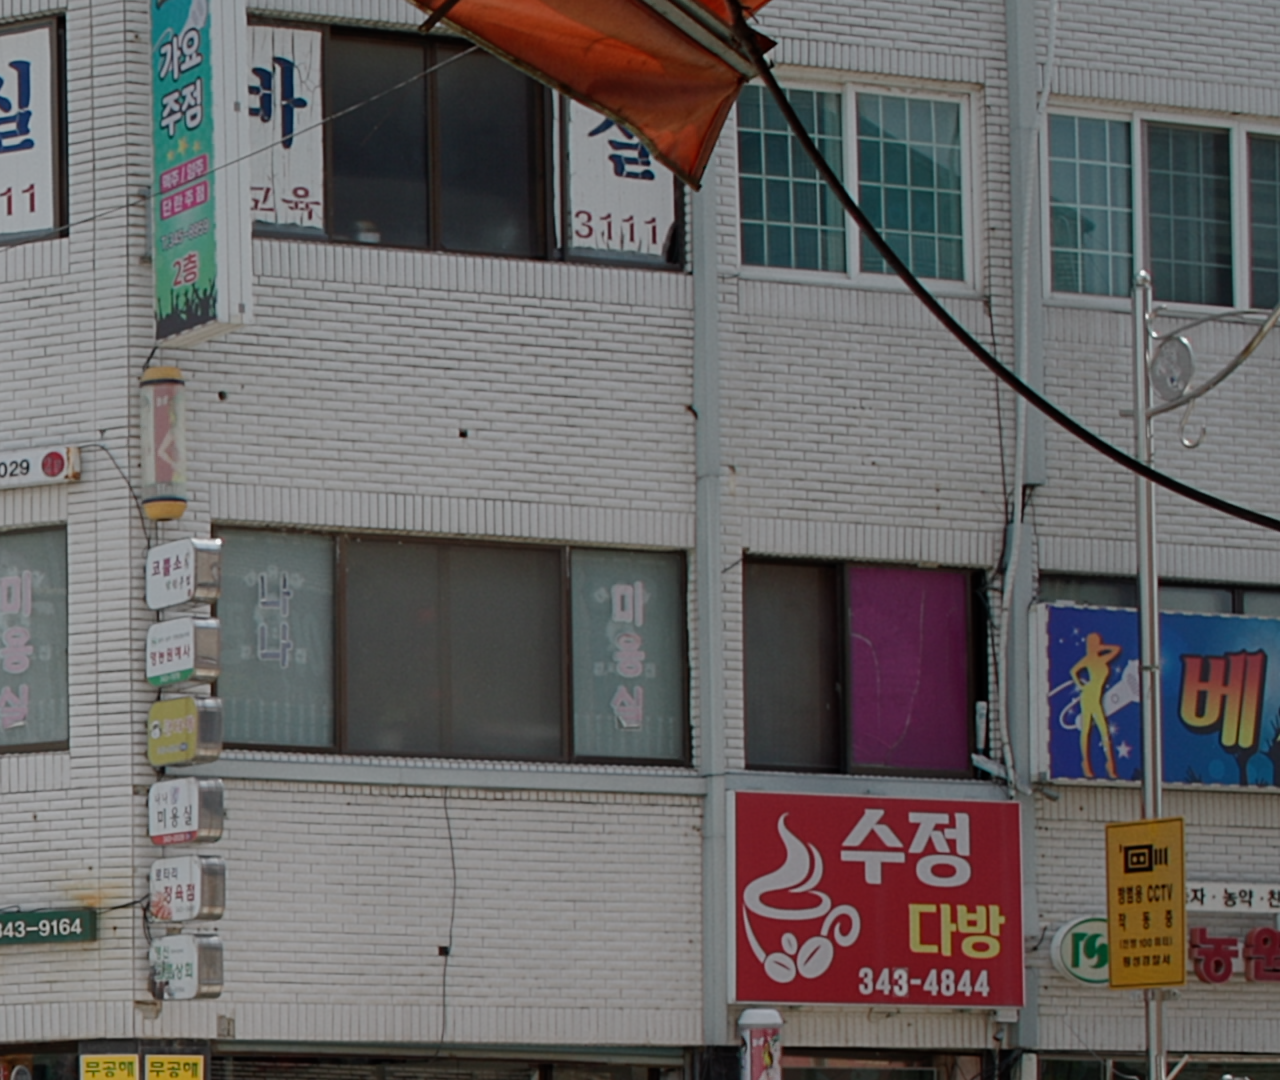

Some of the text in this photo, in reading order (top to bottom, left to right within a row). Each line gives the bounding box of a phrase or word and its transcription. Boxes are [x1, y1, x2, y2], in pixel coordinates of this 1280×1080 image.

[160, 29, 202, 80] 가요
[160, 77, 202, 137] 주점
[161, 183, 205, 217] 단란주점
[574, 210, 660, 247] 3111
[172, 252, 197, 287] 2층
[157, 804, 192, 829] 미용실
[841, 808, 972, 888] 수정
[163, 883, 195, 906] 정육점
[1146, 882, 1173, 902] CCTV
[1224, 888, 1253, 908] 농약
[907, 903, 1006, 959] 다방
[1187, 926, 1280, 985] 농원
[858, 967, 990, 998] 343-4844
[85, 1060, 134, 1078] 무공해
[149, 1060, 199, 1078] 무공해
